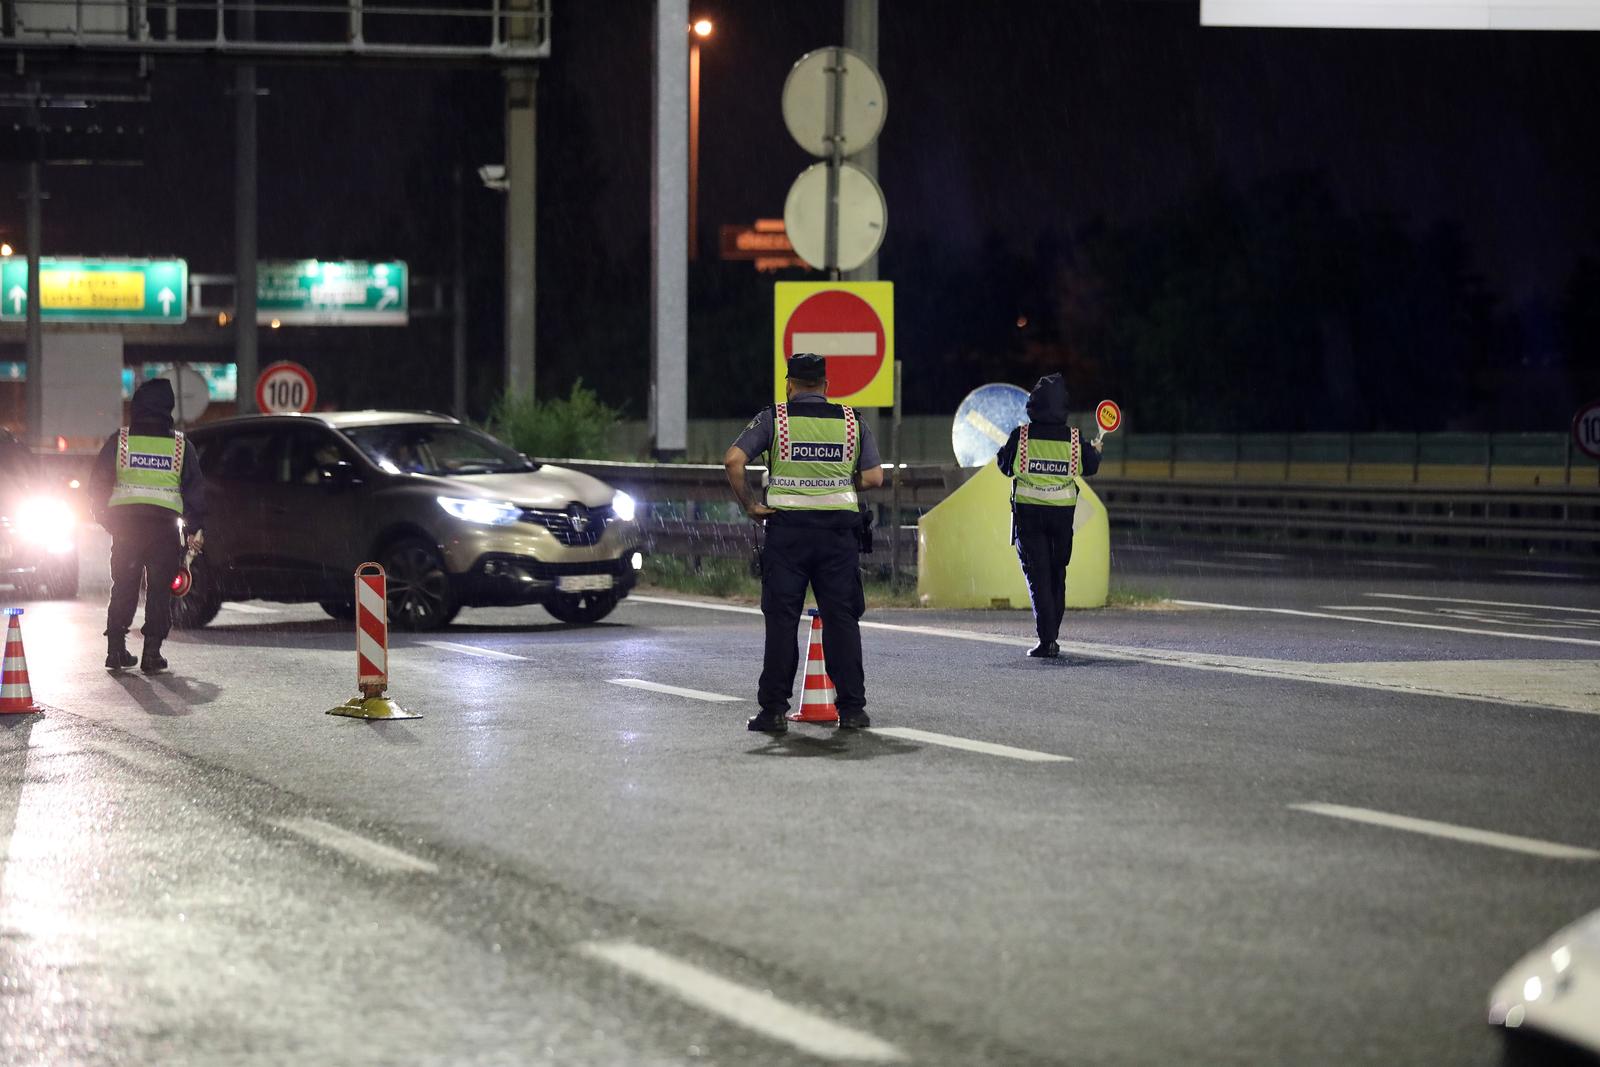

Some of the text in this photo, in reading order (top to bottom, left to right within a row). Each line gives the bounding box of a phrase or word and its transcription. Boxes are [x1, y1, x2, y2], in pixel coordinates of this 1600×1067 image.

[269, 380, 303, 408] 100
[1584, 417, 1600, 444] 10
[792, 446, 841, 457] POLICIJA
[131, 456, 171, 467] POLICIJA
[1030, 462, 1068, 472] POLICIJA
